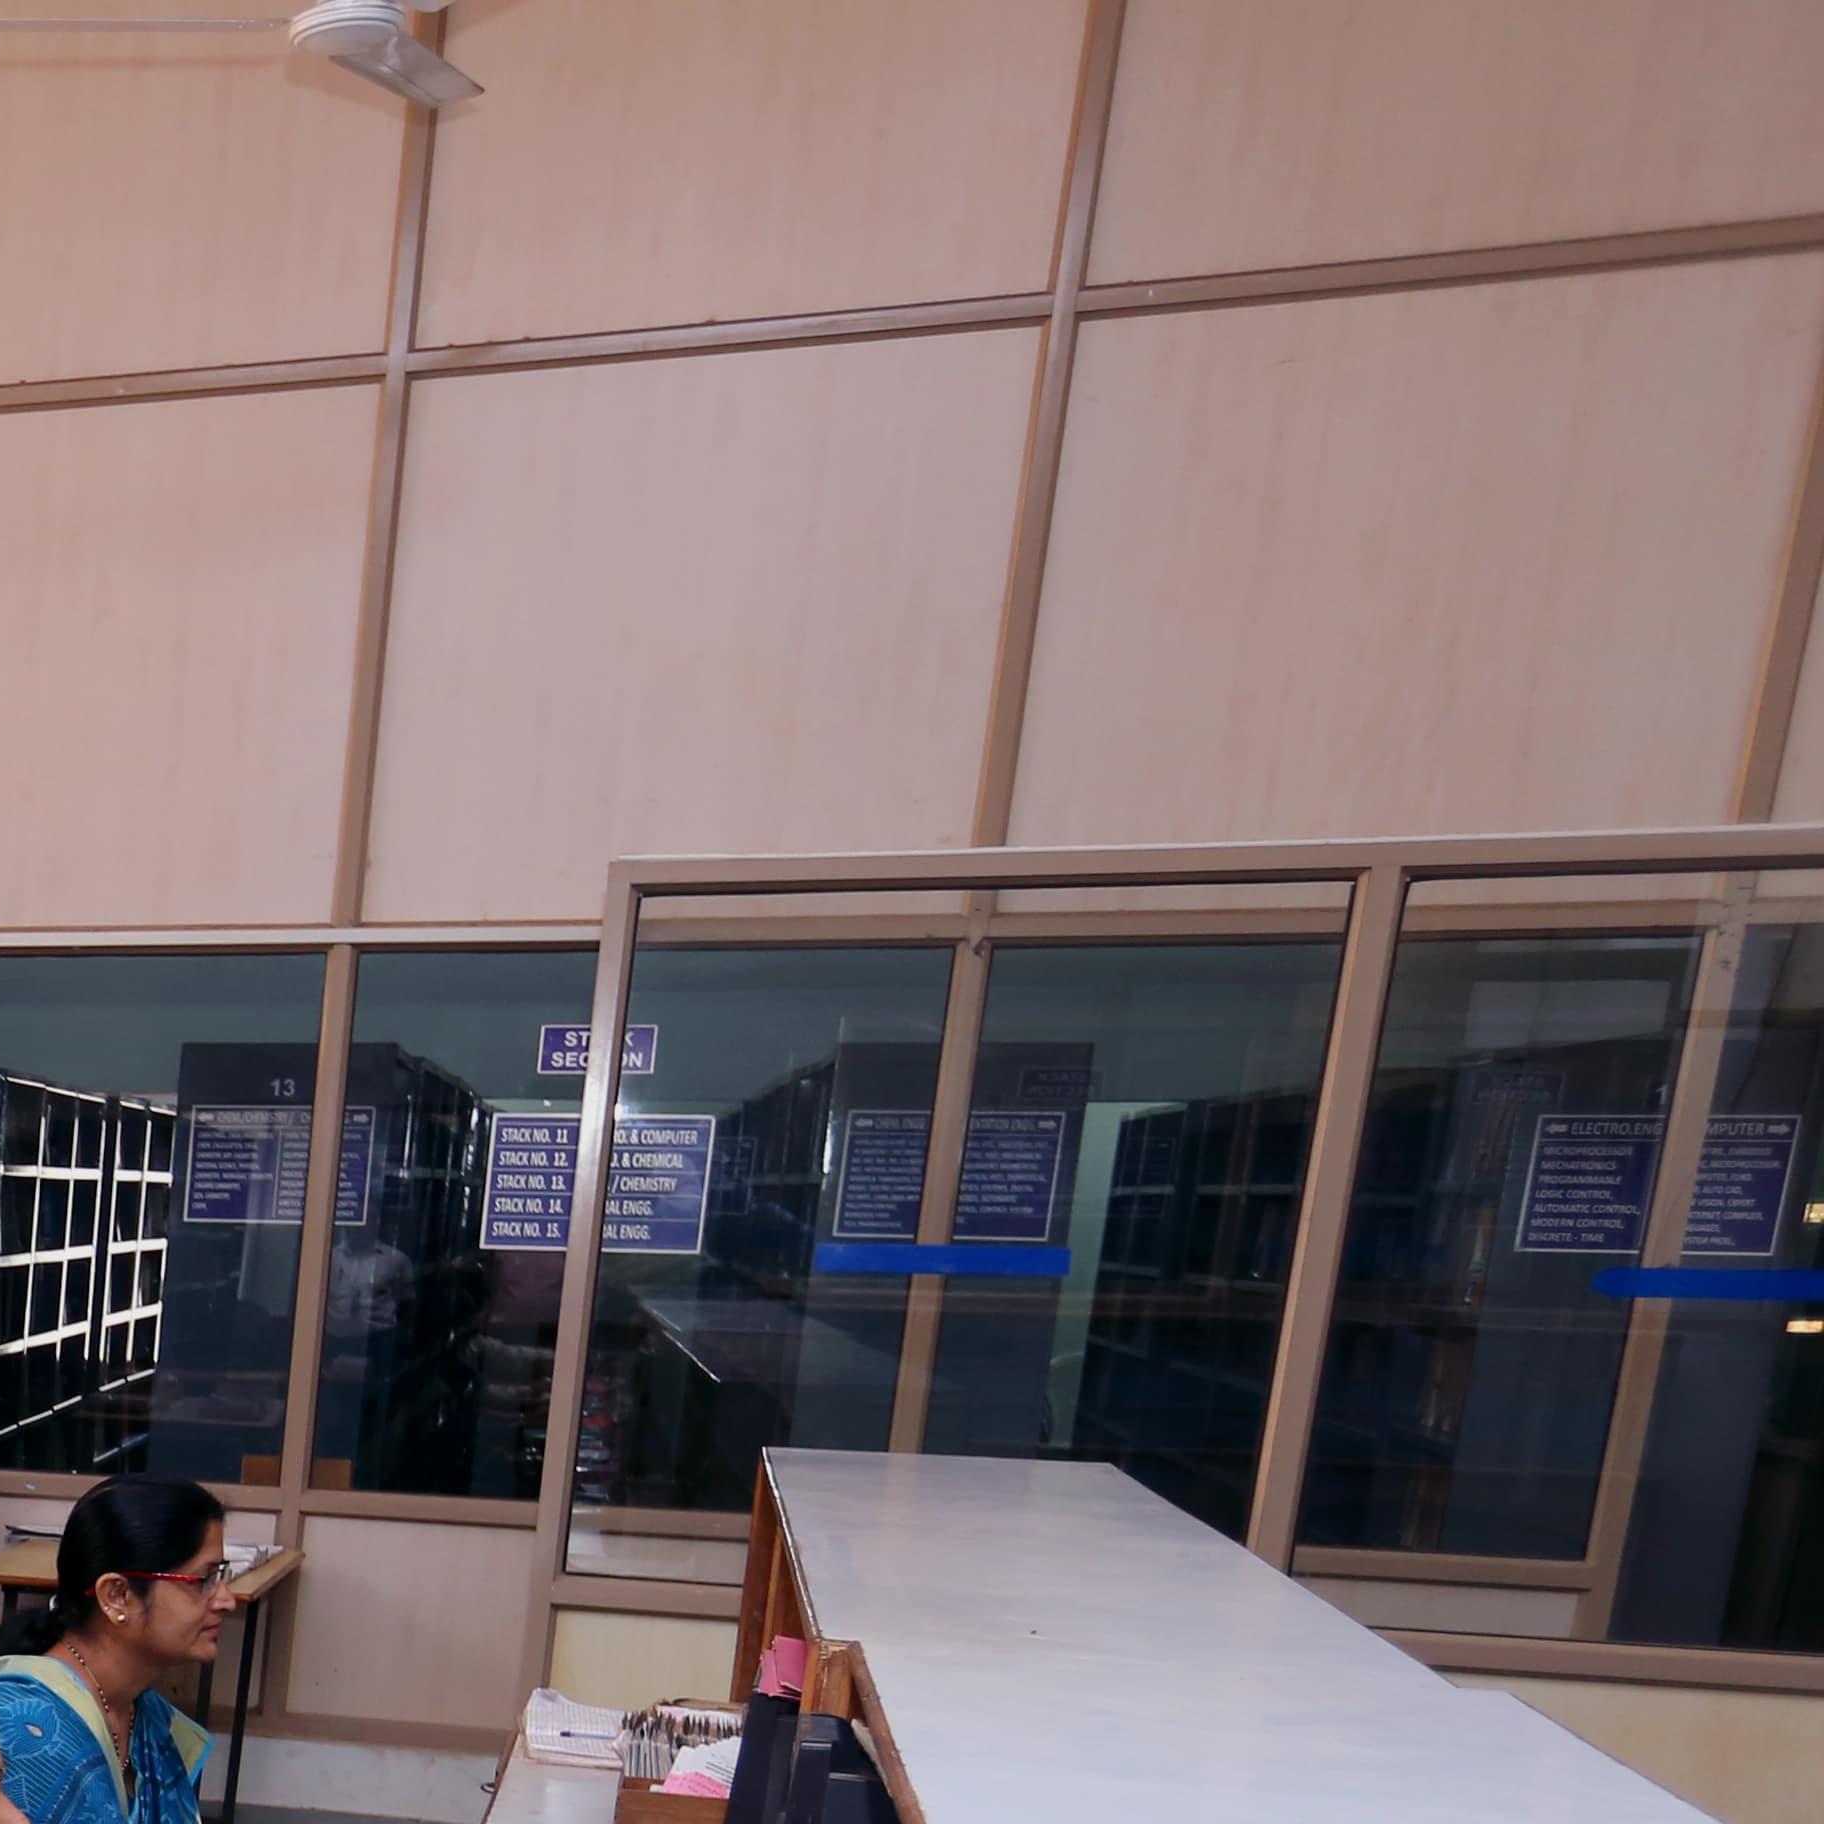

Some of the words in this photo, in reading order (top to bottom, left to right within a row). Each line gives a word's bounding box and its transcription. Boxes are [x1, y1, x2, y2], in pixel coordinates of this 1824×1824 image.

[564, 1031, 634, 1047] STK
[551, 1052, 643, 1068] SECON
[271, 1079, 296, 1097] 13
[502, 1128, 532, 1143] STACK
[533, 1129, 552, 1143] NO.
[556, 1129, 568, 1143] 11
[1571, 1122, 1663, 1135] ELECTRO.ENG
[1706, 1122, 1765, 1135] MPUTER
[641, 1131, 697, 1145] COMPUTER
[499, 1151, 529, 1166] STACK
[530, 1152, 549, 1167] NO.
[633, 1154, 683, 1169] CHEMICAL
[497, 1175, 526, 1189] STACK
[527, 1175, 546, 1190] NO.
[620, 1176, 678, 1192] CHEMISTRY
[1535, 1190, 1563, 1199] LOGIC
[495, 1198, 524, 1213] STACK
[525, 1199, 544, 1213] NO.
[622, 1200, 653, 1216] ENGG.
[1533, 1204, 1589, 1213] AUTOMATIC
[492, 1222, 521, 1237] STACK
[522, 1223, 541, 1238] NO.
[619, 1225, 651, 1240] ENGG.
